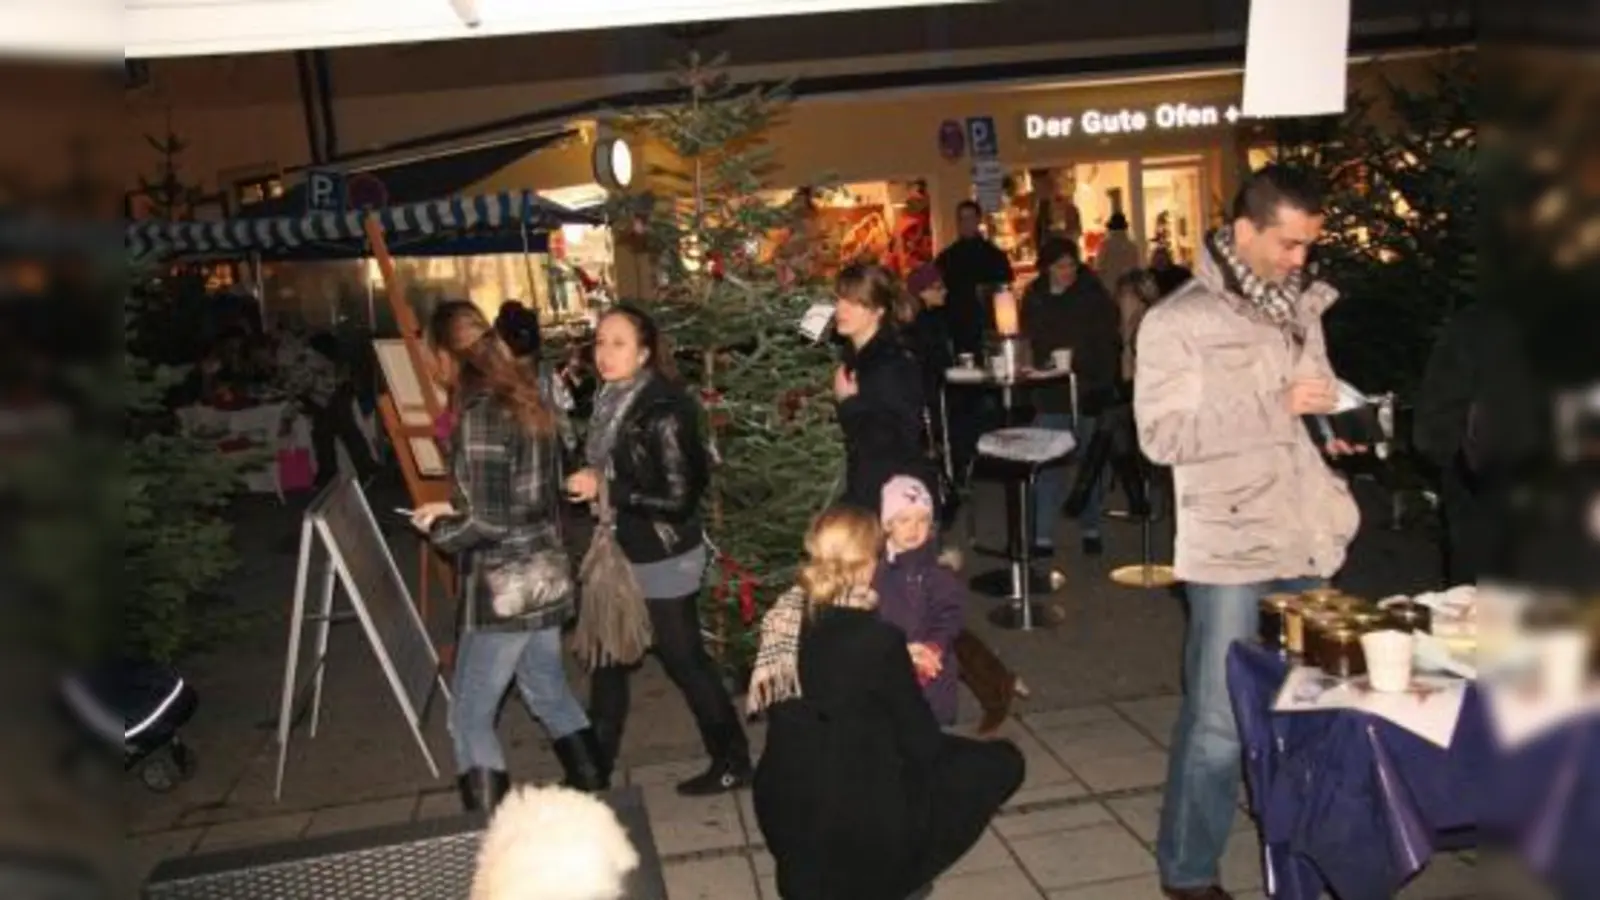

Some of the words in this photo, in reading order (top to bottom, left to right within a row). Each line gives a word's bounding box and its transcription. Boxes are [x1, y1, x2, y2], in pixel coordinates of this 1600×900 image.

[972, 121, 989, 152] P
[1026, 114, 1073, 139] Der
[1081, 109, 1147, 133] Gute
[1155, 103, 1218, 128] Ofen
[311, 174, 334, 208] P
